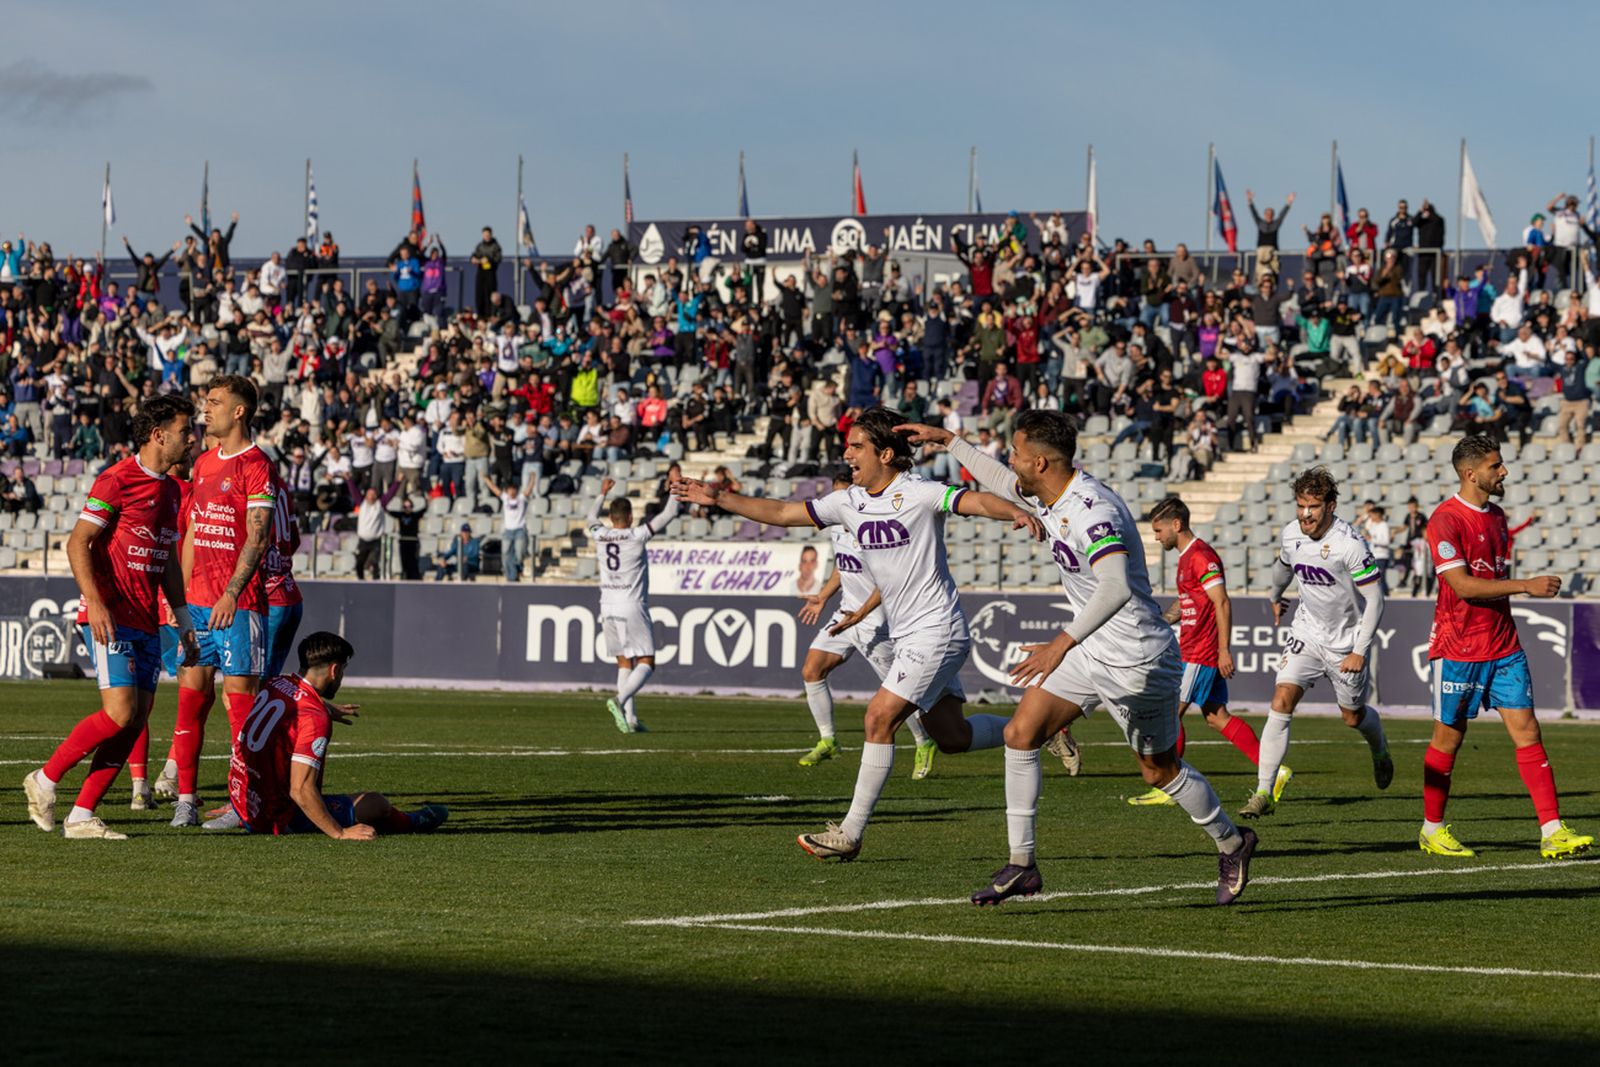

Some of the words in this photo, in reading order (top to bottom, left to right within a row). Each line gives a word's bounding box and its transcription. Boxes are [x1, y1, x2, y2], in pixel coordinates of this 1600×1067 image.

[881, 217, 943, 251] JAÉN
[606, 542, 620, 572] 8
[686, 549, 725, 565] REAL
[727, 545, 772, 566] JAÉN
[676, 568, 706, 590] "EL
[710, 569, 794, 591] CHATO"
[525, 603, 797, 669] mcron
[224, 650, 232, 667] 2
[239, 689, 286, 752] 20
